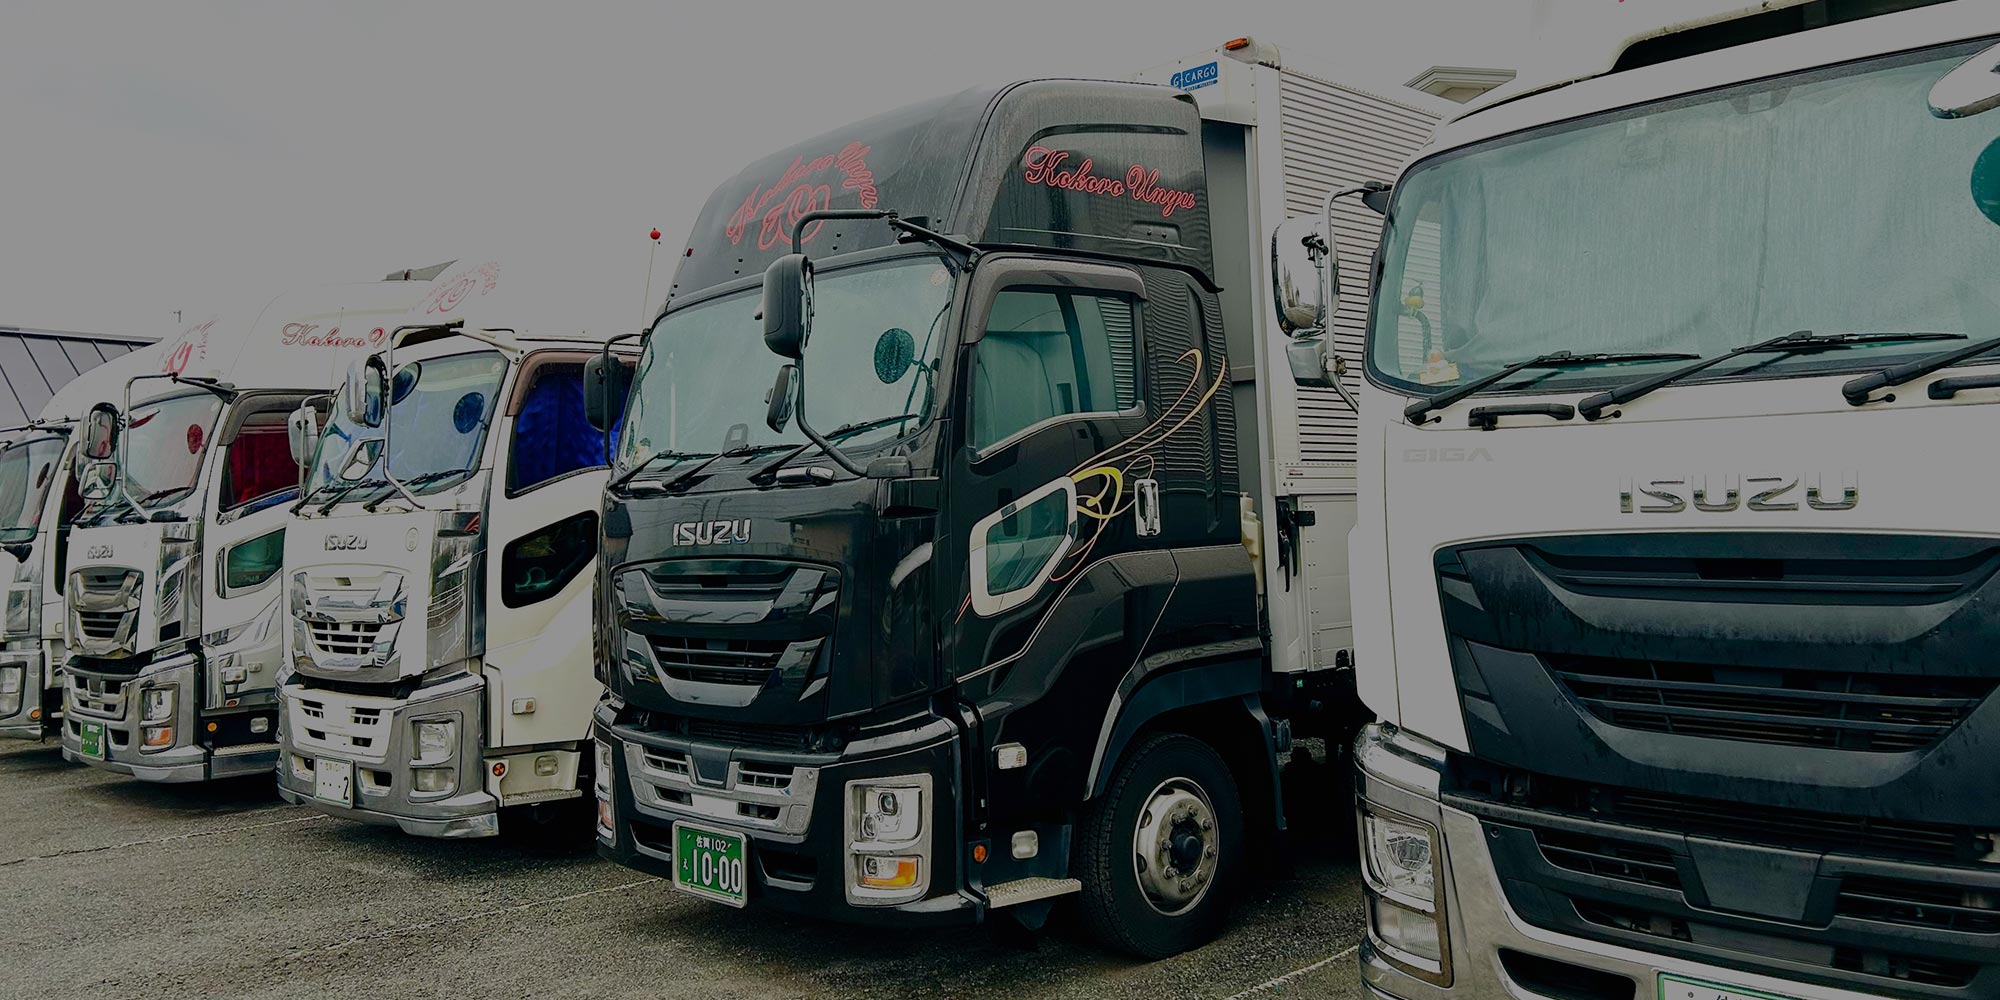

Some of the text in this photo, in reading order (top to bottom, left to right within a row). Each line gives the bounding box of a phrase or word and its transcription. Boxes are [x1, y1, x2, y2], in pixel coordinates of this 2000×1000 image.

[1025, 146, 1195, 217] Kokoro Unyu
[282, 322, 366, 348] Kokoro
[1402, 448, 1494, 463] GIGA
[1619, 471, 1859, 513] ISUZU
[325, 534, 368, 551] ISUZU
[673, 519, 751, 546] ISUZU
